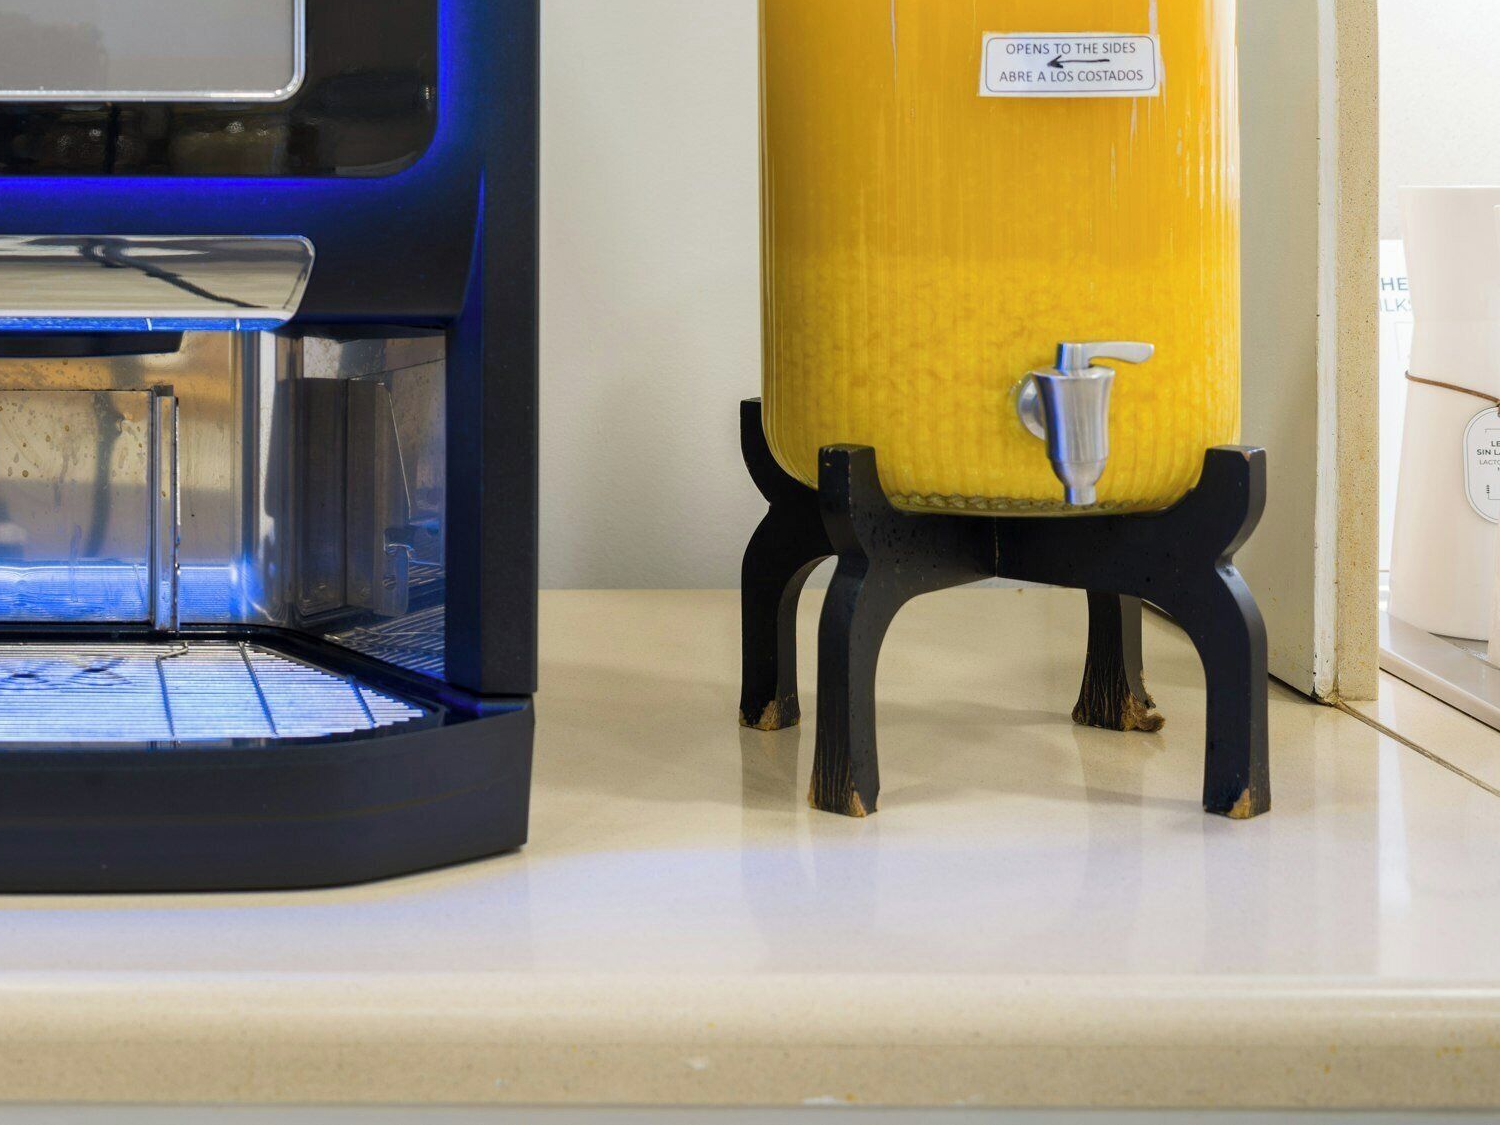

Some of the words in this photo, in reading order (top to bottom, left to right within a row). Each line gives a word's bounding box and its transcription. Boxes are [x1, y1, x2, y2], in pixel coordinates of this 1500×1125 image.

[1006, 43, 1050, 55] OPENS
[1055, 43, 1071, 54] TO
[1076, 43, 1098, 54] THE
[1102, 42, 1136, 54] SIDES
[999, 71, 1033, 82] ABRE
[1037, 71, 1046, 82] A
[1050, 71, 1074, 82] LOS
[1077, 70, 1143, 82] COSTADOS
